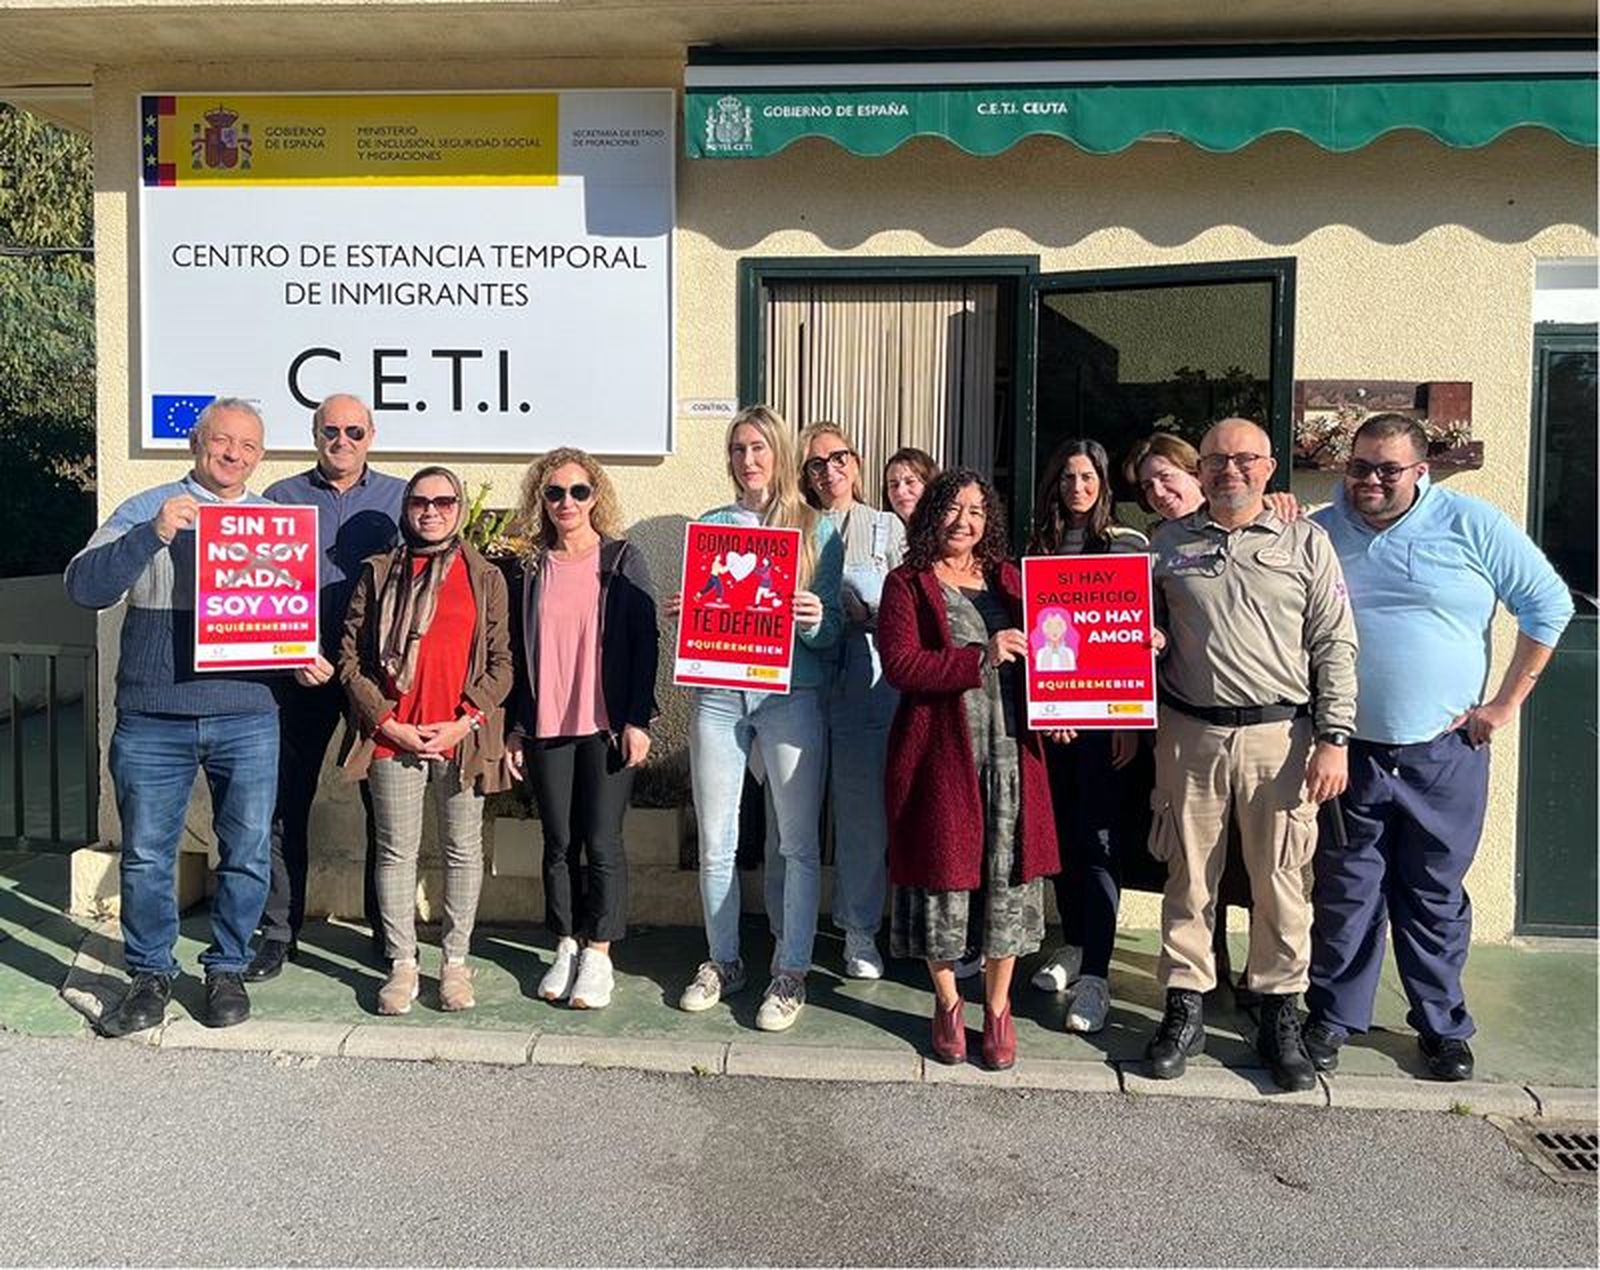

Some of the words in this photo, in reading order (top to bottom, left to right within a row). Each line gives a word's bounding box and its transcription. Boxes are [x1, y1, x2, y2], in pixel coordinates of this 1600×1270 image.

[762, 105, 832, 118] GOBIERNO
[835, 105, 854, 117] DE
[857, 101, 909, 116] ESPAÑA
[976, 102, 1019, 115] C.E.T.I.
[1023, 101, 1068, 114] CEUTA
[264, 127, 326, 137] GOBIERNO
[357, 126, 418, 136] MINISTERIO
[265, 139, 281, 149] DE
[283, 138, 326, 149] ESPAÑA
[357, 139, 372, 149] DE
[438, 138, 500, 149] SEGURIDAD
[503, 138, 542, 148] SOCIAL
[357, 151, 364, 160] Y
[367, 151, 442, 161] MIGRACIONES
[172, 244, 290, 268] CENTRO
[299, 244, 337, 268] DE
[347, 244, 482, 268] ESTANCIA
[491, 244, 647, 269] TEMPORAL
[285, 283, 321, 305] DE
[331, 282, 529, 306] INMIGRANTES
[220, 516, 265, 536] SIN
[272, 517, 296, 536] TI
[207, 543, 249, 561] NO
[255, 543, 309, 561] SOY
[697, 533, 742, 552] COMO
[746, 535, 789, 557] AMAS
[215, 569, 302, 590] NADA,
[1057, 572, 1074, 585] SI
[1079, 571, 1115, 584] HAY
[206, 596, 263, 616] SOY
[270, 595, 309, 615] YO
[692, 608, 713, 633] TE
[719, 611, 784, 638] DEFINE
[1073, 610, 1101, 624] NO
[1105, 609, 1144, 623] HAY
[1088, 629, 1144, 644] AMOR
[1037, 679, 1145, 690] #QUIÉREMEBIEN
